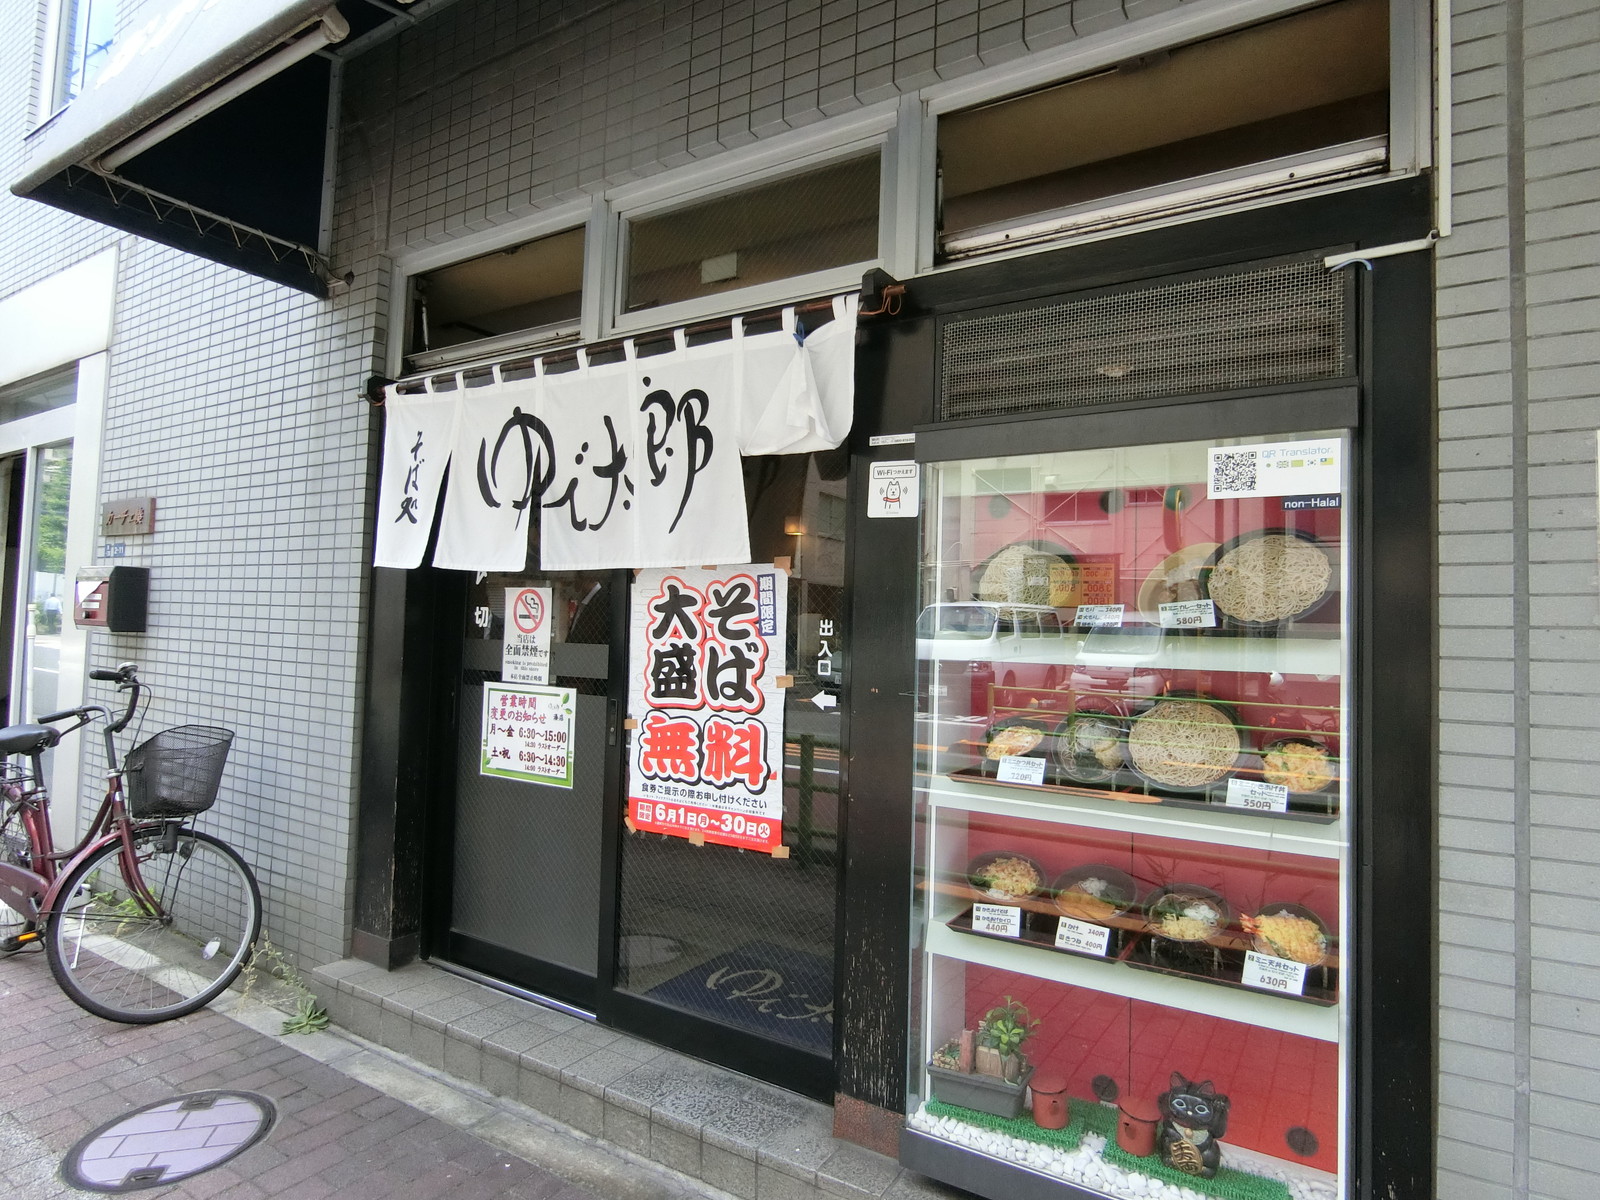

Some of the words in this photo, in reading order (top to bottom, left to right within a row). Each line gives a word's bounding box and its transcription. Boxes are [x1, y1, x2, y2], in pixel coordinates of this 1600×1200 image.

[1262, 450, 1276, 459] QR
[395, 430, 423, 524] そば処
[1284, 497, 1339, 509] non-Halal
[760, 576, 774, 634] 期間限定
[1176, 616, 1202, 625] 580円
[517, 634, 536, 644] 当店は
[651, 584, 699, 700] 大盛
[706, 582, 758, 704] そば
[505, 644, 548, 657] 全面禁煙です
[818, 619, 833, 675] 出入口
[500, 694, 537, 710] 営業時間
[491, 707, 547, 725] 変更のお知らせ
[538, 743, 565, 751] ラストオーダー
[642, 714, 764, 787] 無料
[537, 766, 565, 775] ラストオーダー
[1011, 773, 1032, 781] 720円
[641, 782, 768, 809] 食券ご提示の際お申し付けください
[1244, 799, 1271, 810] 550円
[986, 924, 1007, 933] 440円
[1088, 929, 1105, 938] 340円
[1065, 936, 1081, 945] きつね
[1085, 941, 1102, 950] 400円
[1255, 956, 1299, 972] ミニ天丼セット
[1260, 975, 1288, 989] 630円
